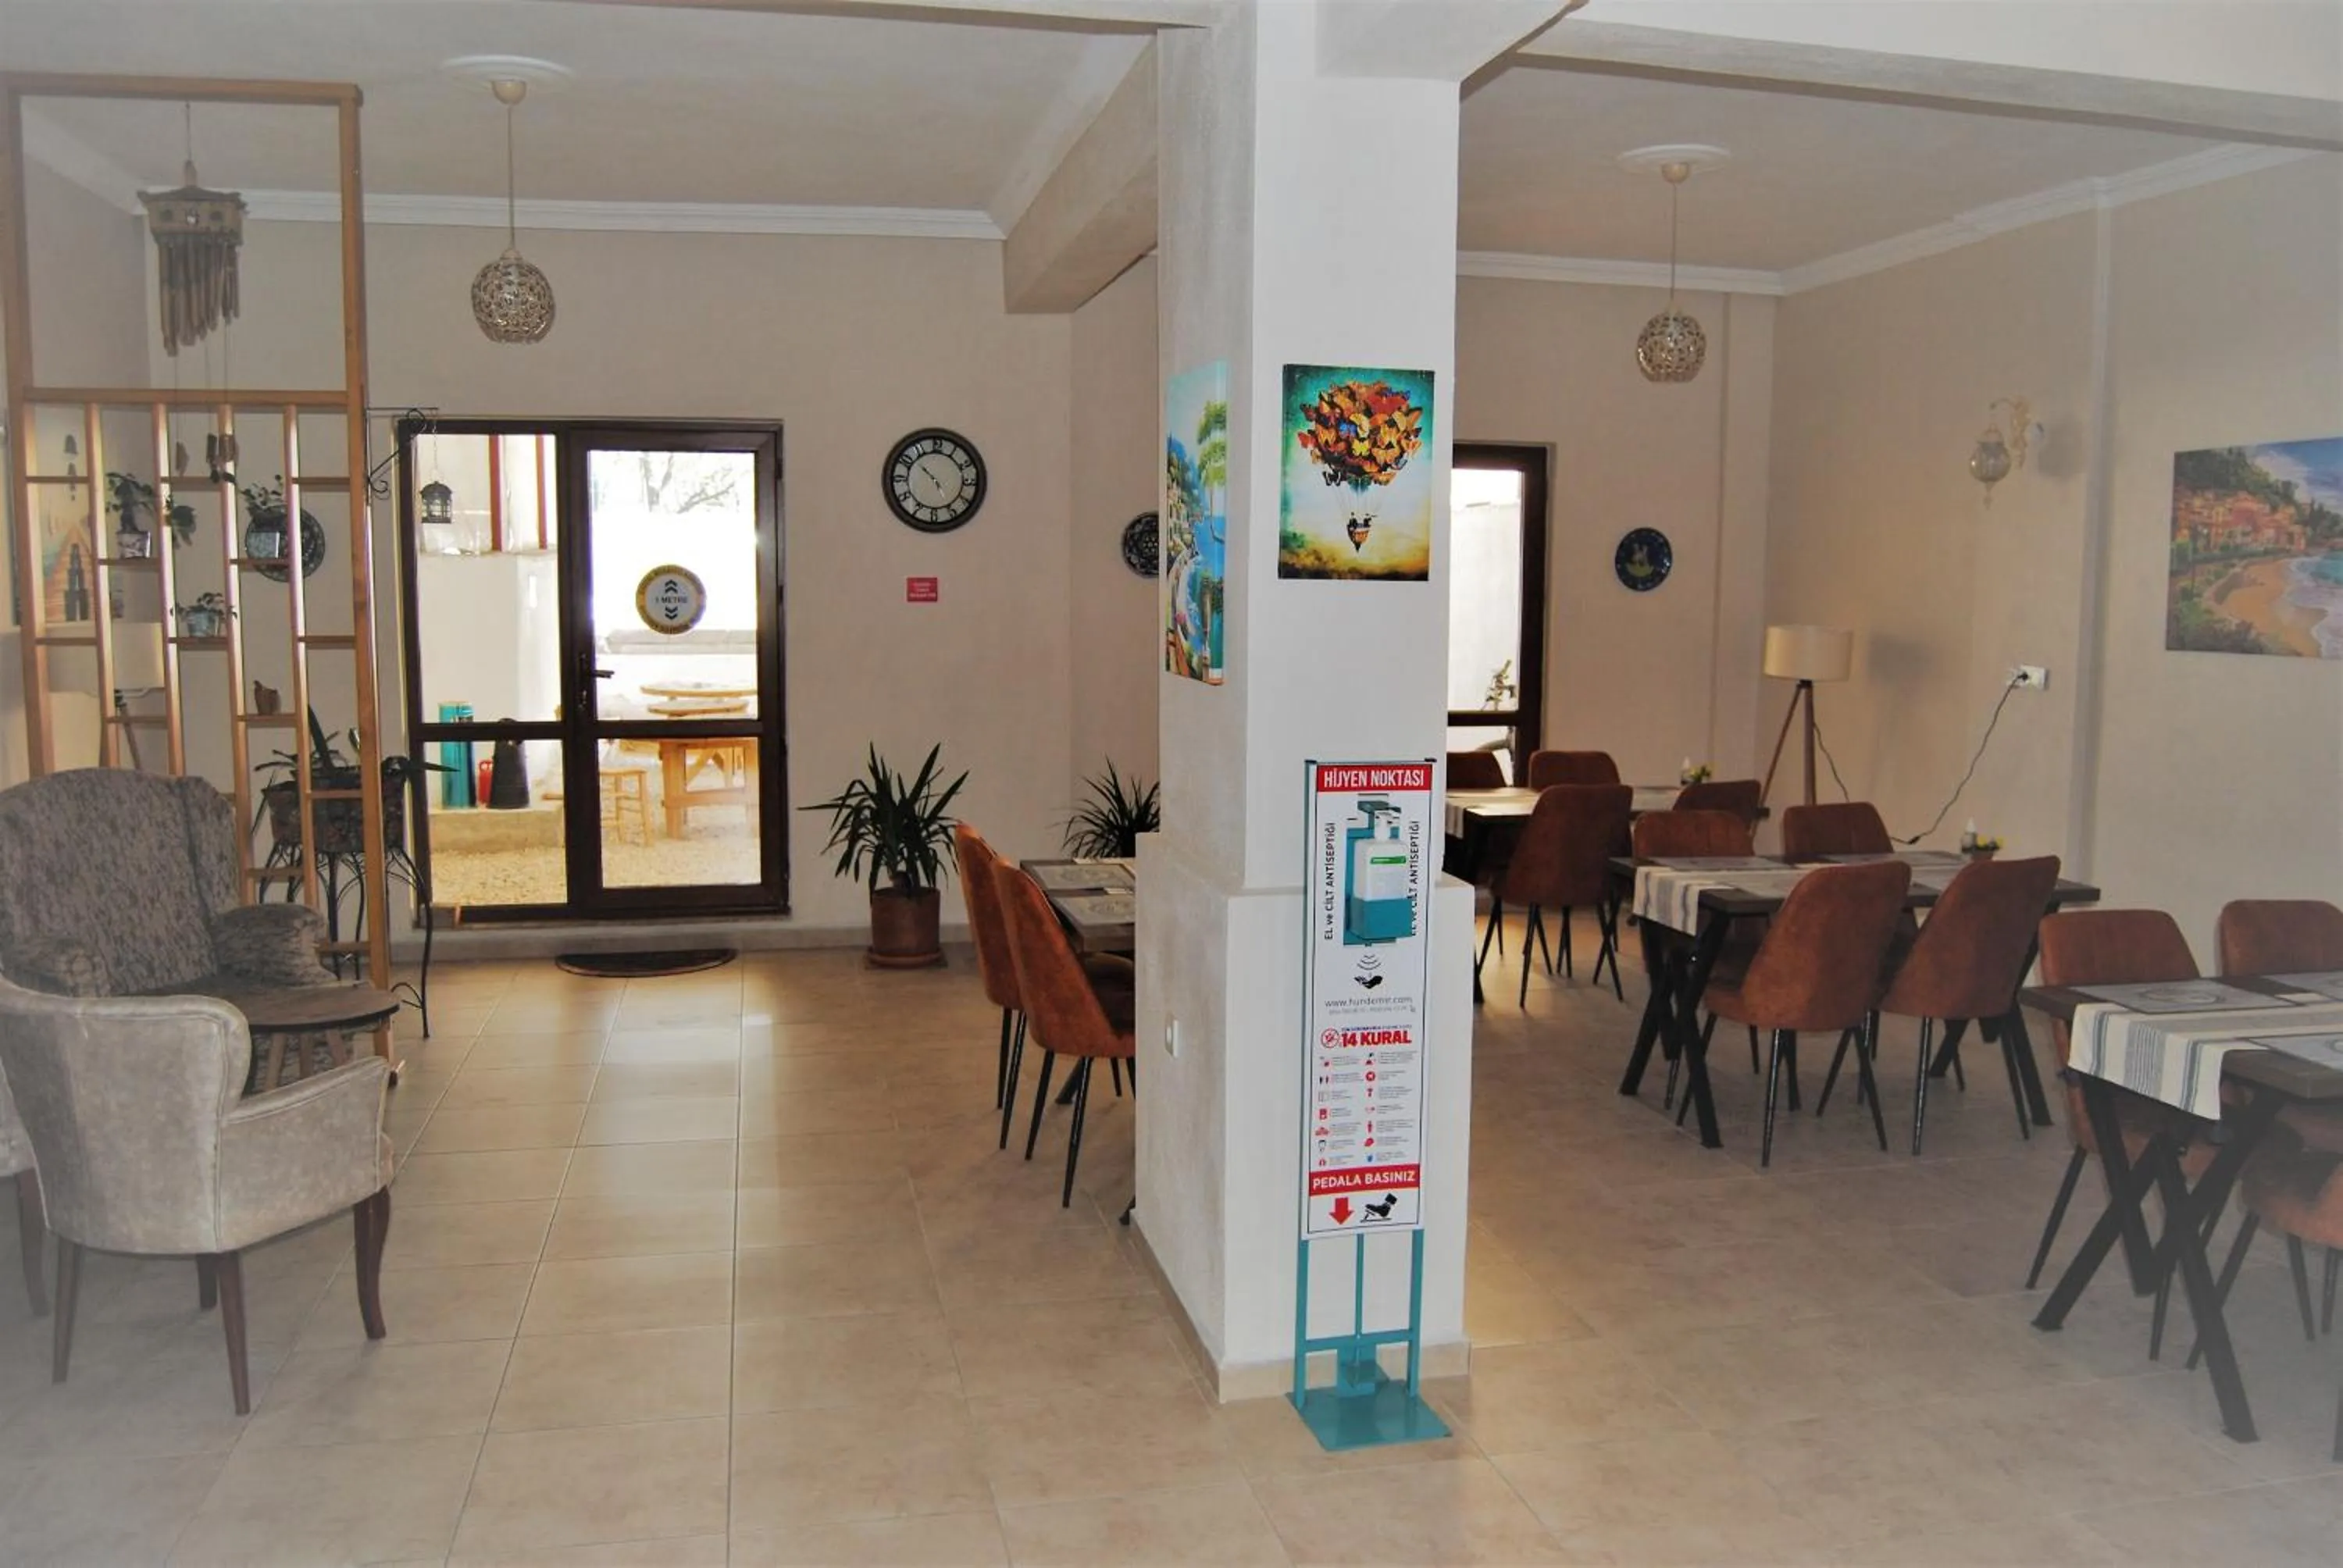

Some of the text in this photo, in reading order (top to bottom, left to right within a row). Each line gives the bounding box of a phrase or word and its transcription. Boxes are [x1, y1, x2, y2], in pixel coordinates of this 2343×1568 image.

[898, 454, 914, 468] 10
[1324, 768, 1425, 788] HİJYEN NOKTASI
[1409, 821, 1419, 885] ANTİSEPTİĞİ
[1324, 822, 1336, 940] EL ve CİLT ANTİSEPTİĞİ
[1342, 1030, 1412, 1048] 14 KURAL
[1313, 1171, 1415, 1190] PEDALA BASINIZ
